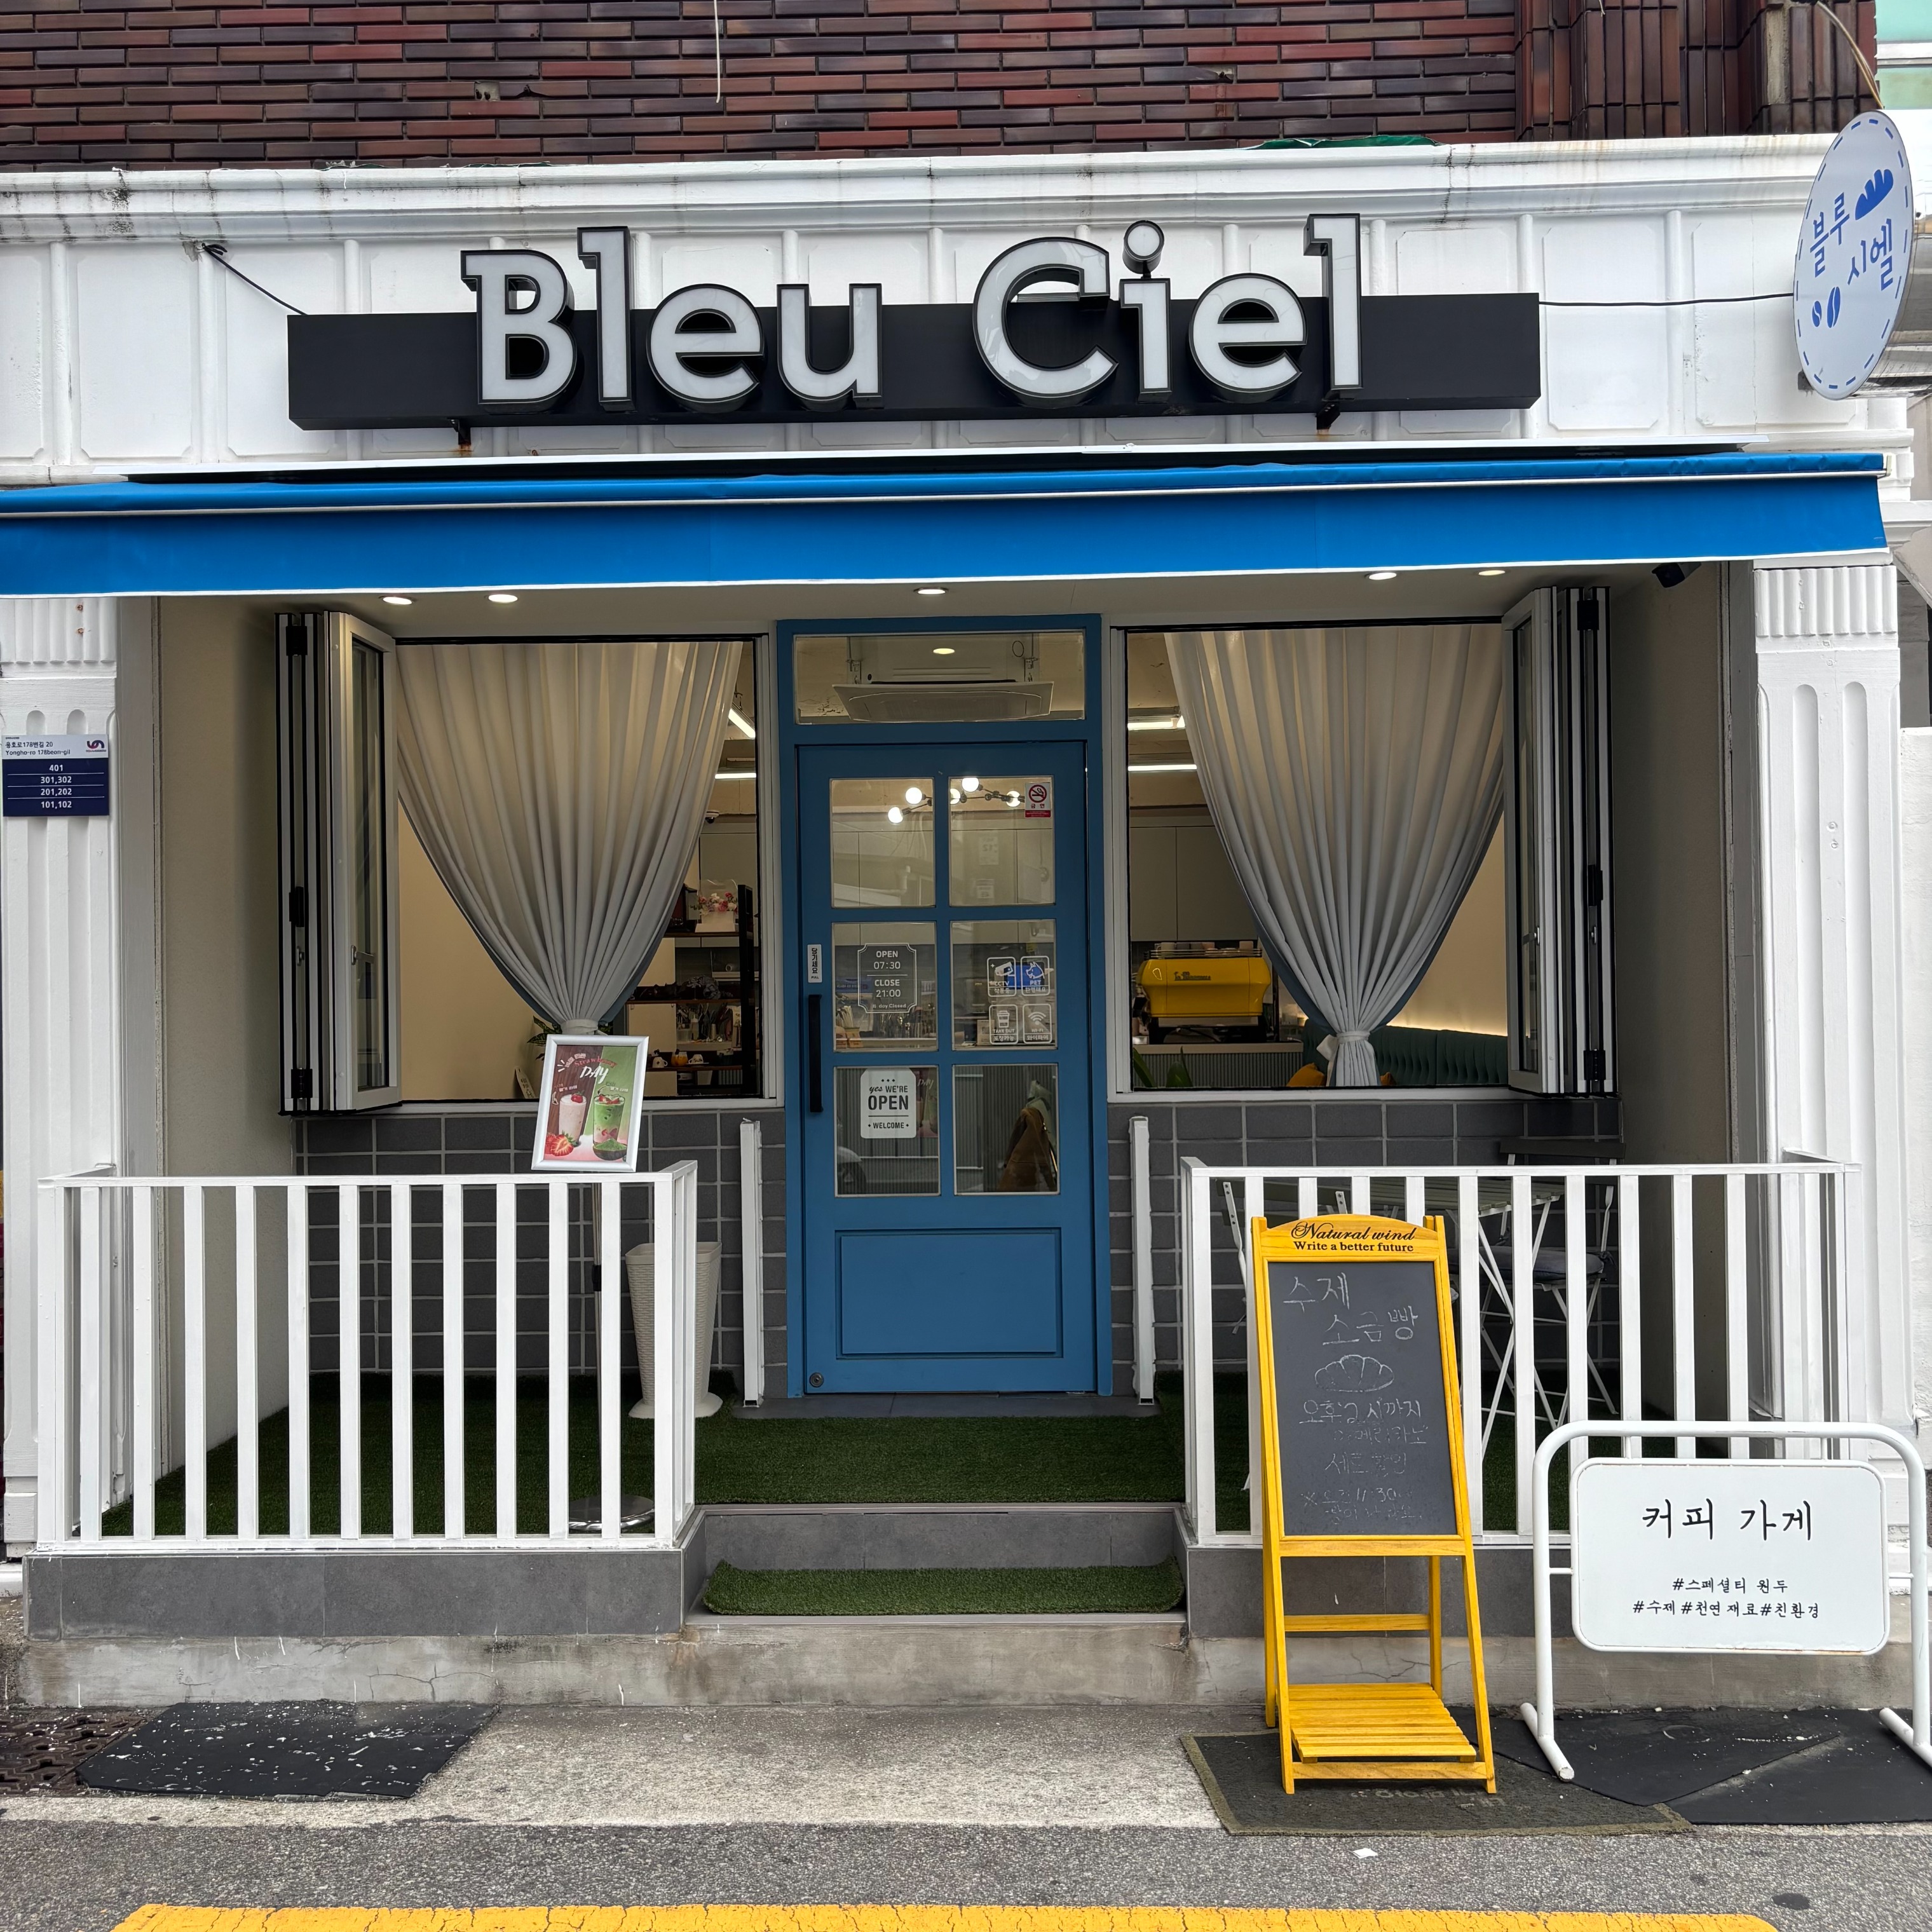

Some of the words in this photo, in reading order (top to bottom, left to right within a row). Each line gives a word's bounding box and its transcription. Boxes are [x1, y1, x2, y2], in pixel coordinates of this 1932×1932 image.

[1810, 192, 1850, 278] 블루
[1847, 218, 1894, 291] 시엘
[460, 226, 882, 412] Bleu
[972, 214, 1361, 407] Ciel
[40, 776, 72, 784] 301,302
[40, 788, 72, 796] 201,202
[41, 801, 72, 809] 101,102
[876, 990, 901, 998] 21:00
[580, 1065, 609, 1084] DAY
[868, 1095, 909, 1110] OPEN
[1291, 1221, 1371, 1240] Natural
[1372, 1227, 1418, 1241] wind
[1293, 1241, 1328, 1251] Write
[1340, 1242, 1375, 1251] better
[1377, 1242, 1414, 1252] future
[1282, 1272, 1350, 1313] 수제
[1642, 1498, 1714, 1540] 커피
[1739, 1499, 1812, 1541] 가게
[1672, 1577, 1746, 1595] #스페셜티
[1756, 1578, 1788, 1593] 원두
